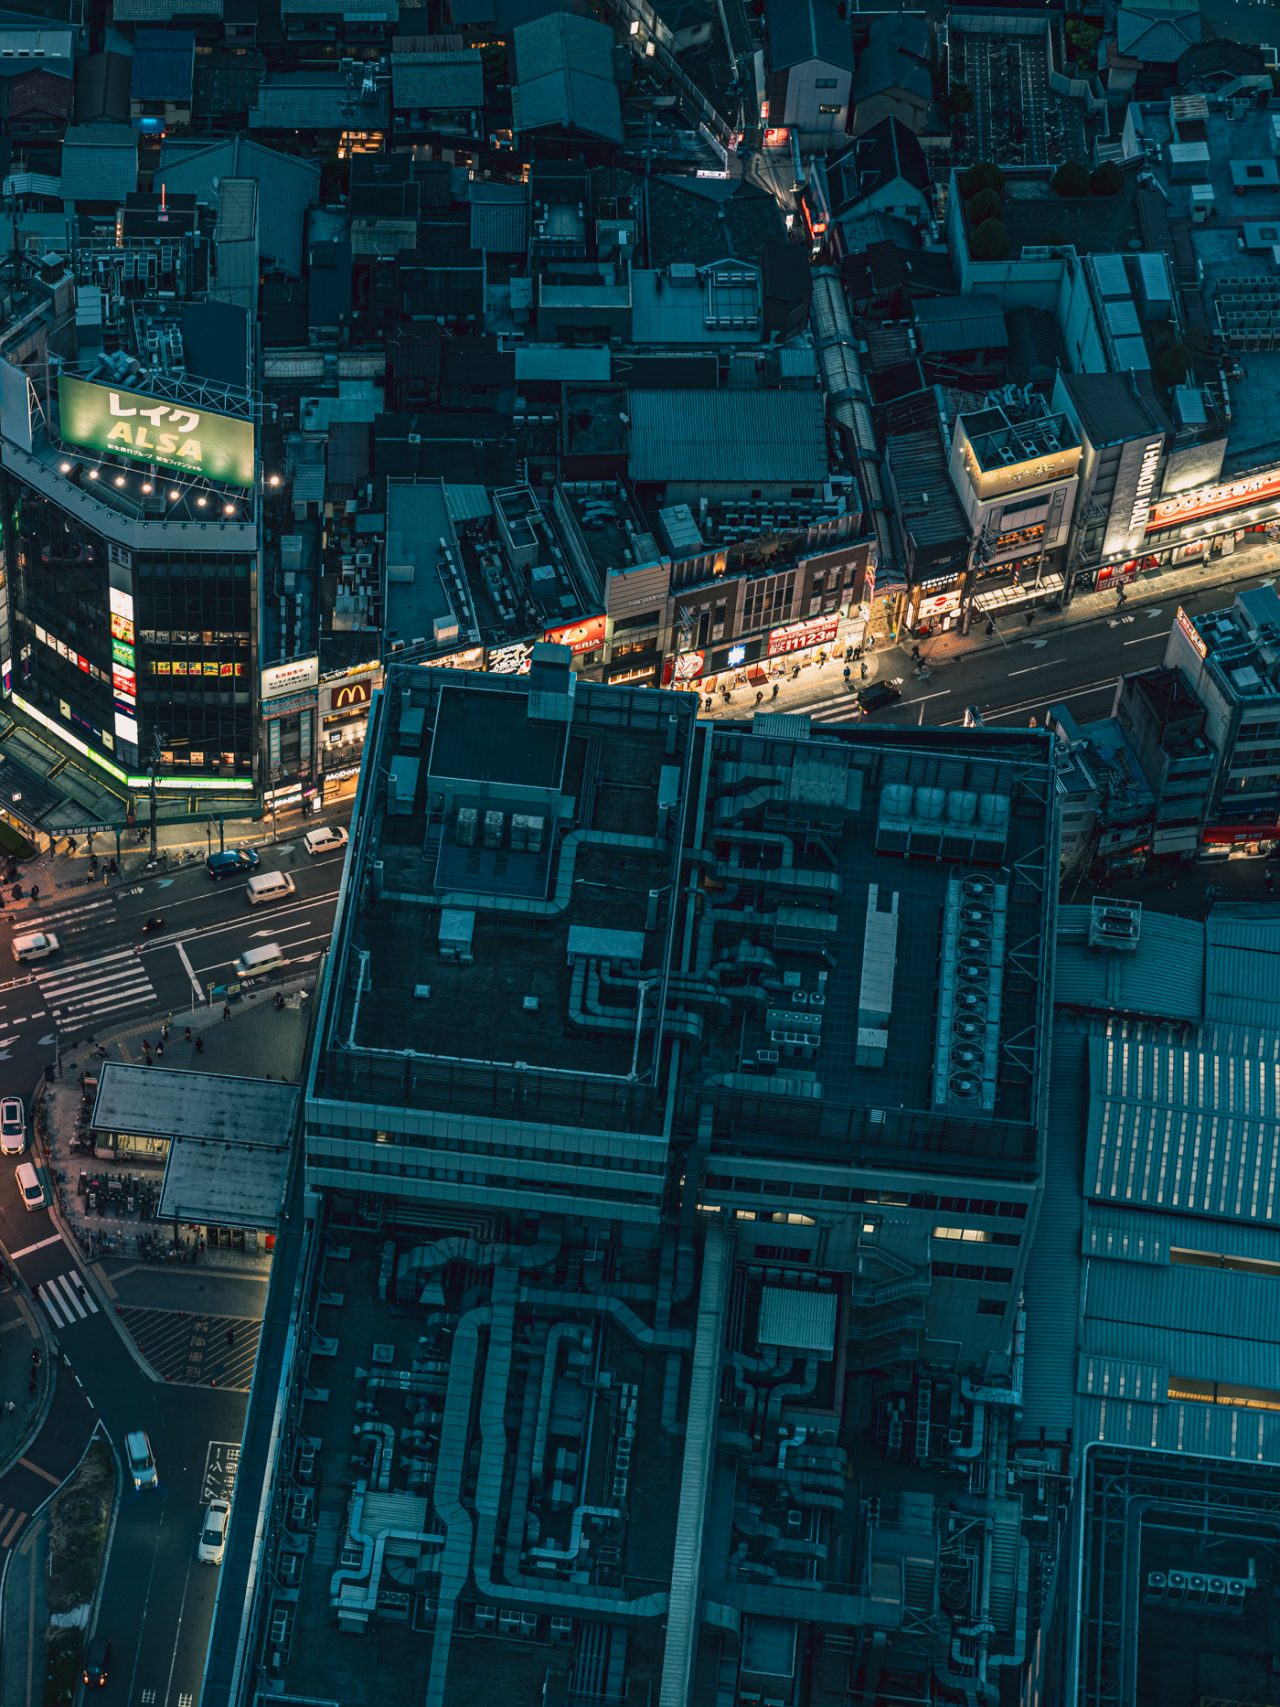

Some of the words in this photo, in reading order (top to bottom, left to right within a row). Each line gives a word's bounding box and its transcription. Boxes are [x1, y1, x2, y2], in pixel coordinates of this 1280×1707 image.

[109, 392, 200, 433] レイク
[106, 420, 203, 462] ALSA
[1128, 497, 1150, 531] HALL
[570, 637, 601, 650] TERIA
[325, 767, 361, 781] McDon
[204, 1447, 223, 1498] タクシー
